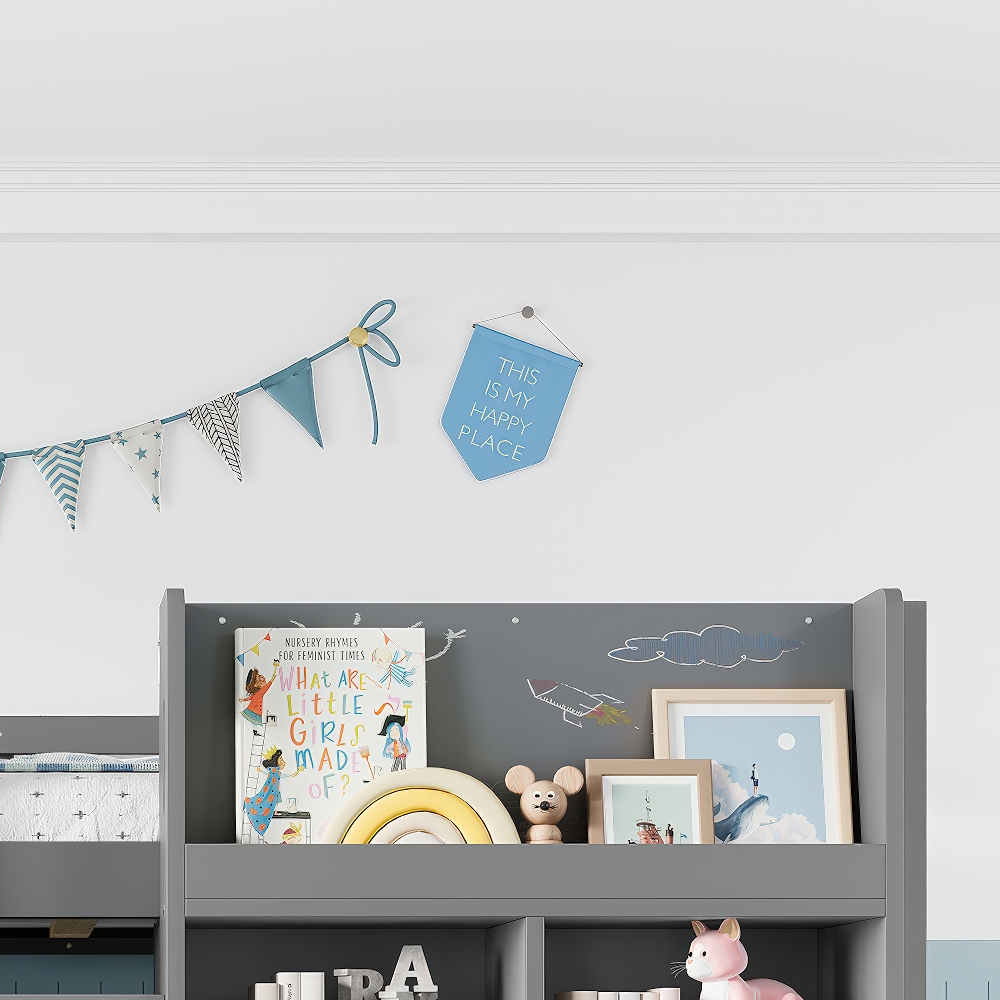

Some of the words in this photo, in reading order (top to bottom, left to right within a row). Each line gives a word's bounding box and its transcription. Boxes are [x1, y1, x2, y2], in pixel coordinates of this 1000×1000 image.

[499, 356, 541, 385] THIS
[484, 379, 501, 399] IS
[503, 386, 536, 410] MY
[469, 401, 533, 436] HAPPY
[457, 424, 526, 462] PLACE
[278, 650, 295, 661] FOR
[297, 650, 336, 661] FEMINIST
[340, 650, 365, 661] TIMES
[285, 637, 322, 648] NURSERY
[325, 637, 359, 648] RHYMES
[338, 669, 367, 691] ARE
